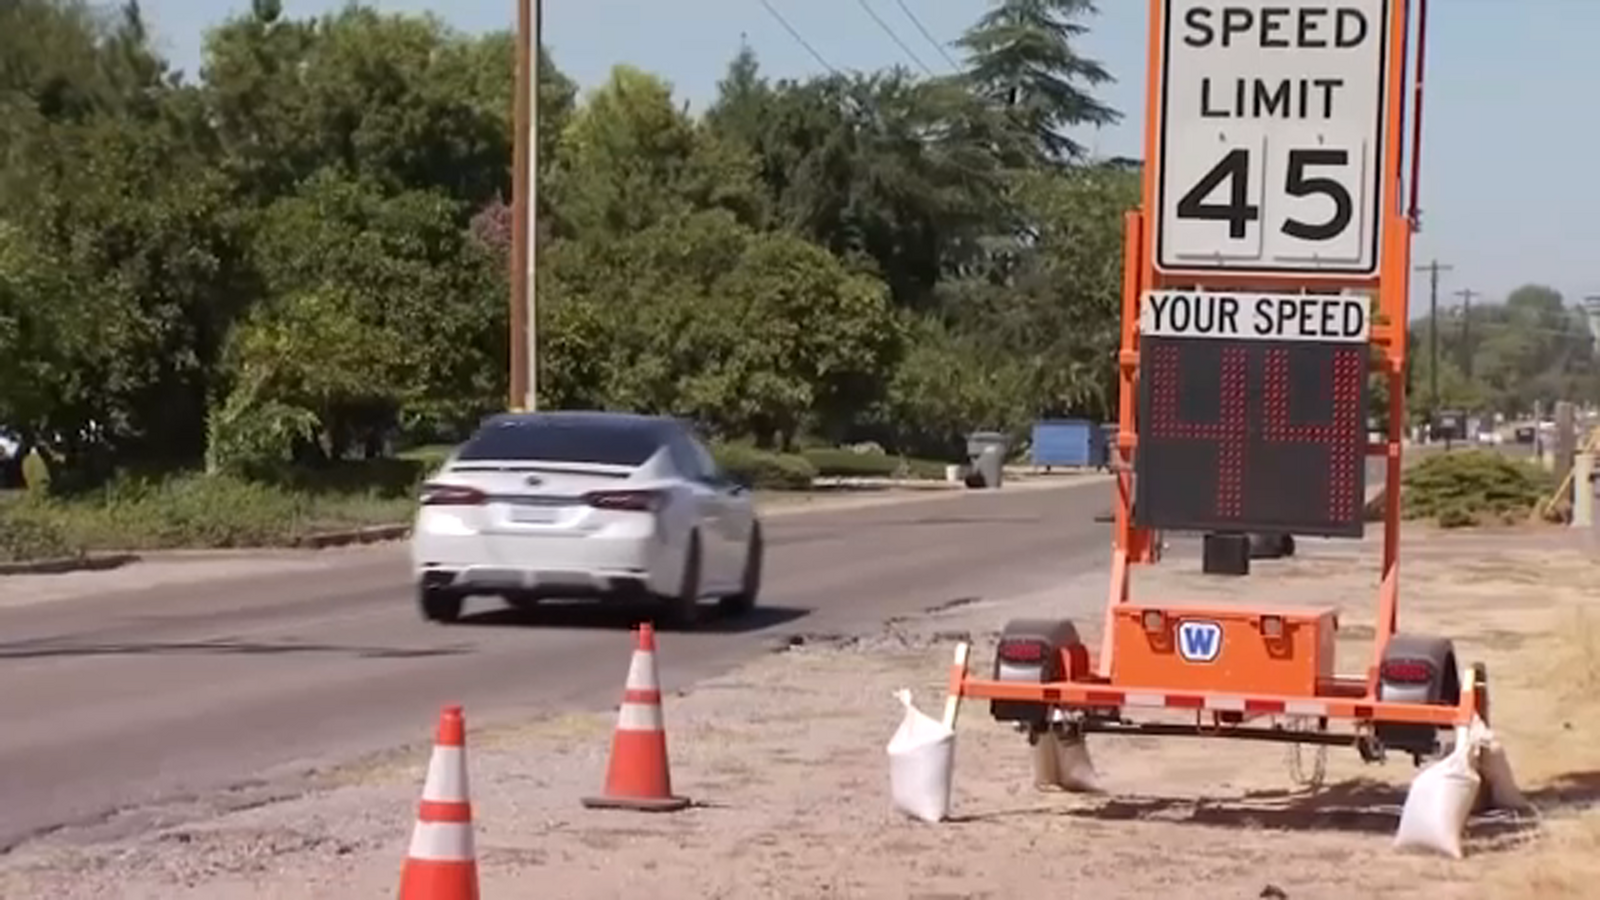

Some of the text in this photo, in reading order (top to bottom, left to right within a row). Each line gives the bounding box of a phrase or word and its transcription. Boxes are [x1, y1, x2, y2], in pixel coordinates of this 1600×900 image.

[1183, 8, 1368, 48] SPEED
[1200, 78, 1344, 119] LIMIT
[1177, 149, 1353, 241] 45
[1149, 295, 1364, 337] YOUR SPEED
[1151, 346, 1360, 521] 44
[1184, 627, 1216, 655] W
